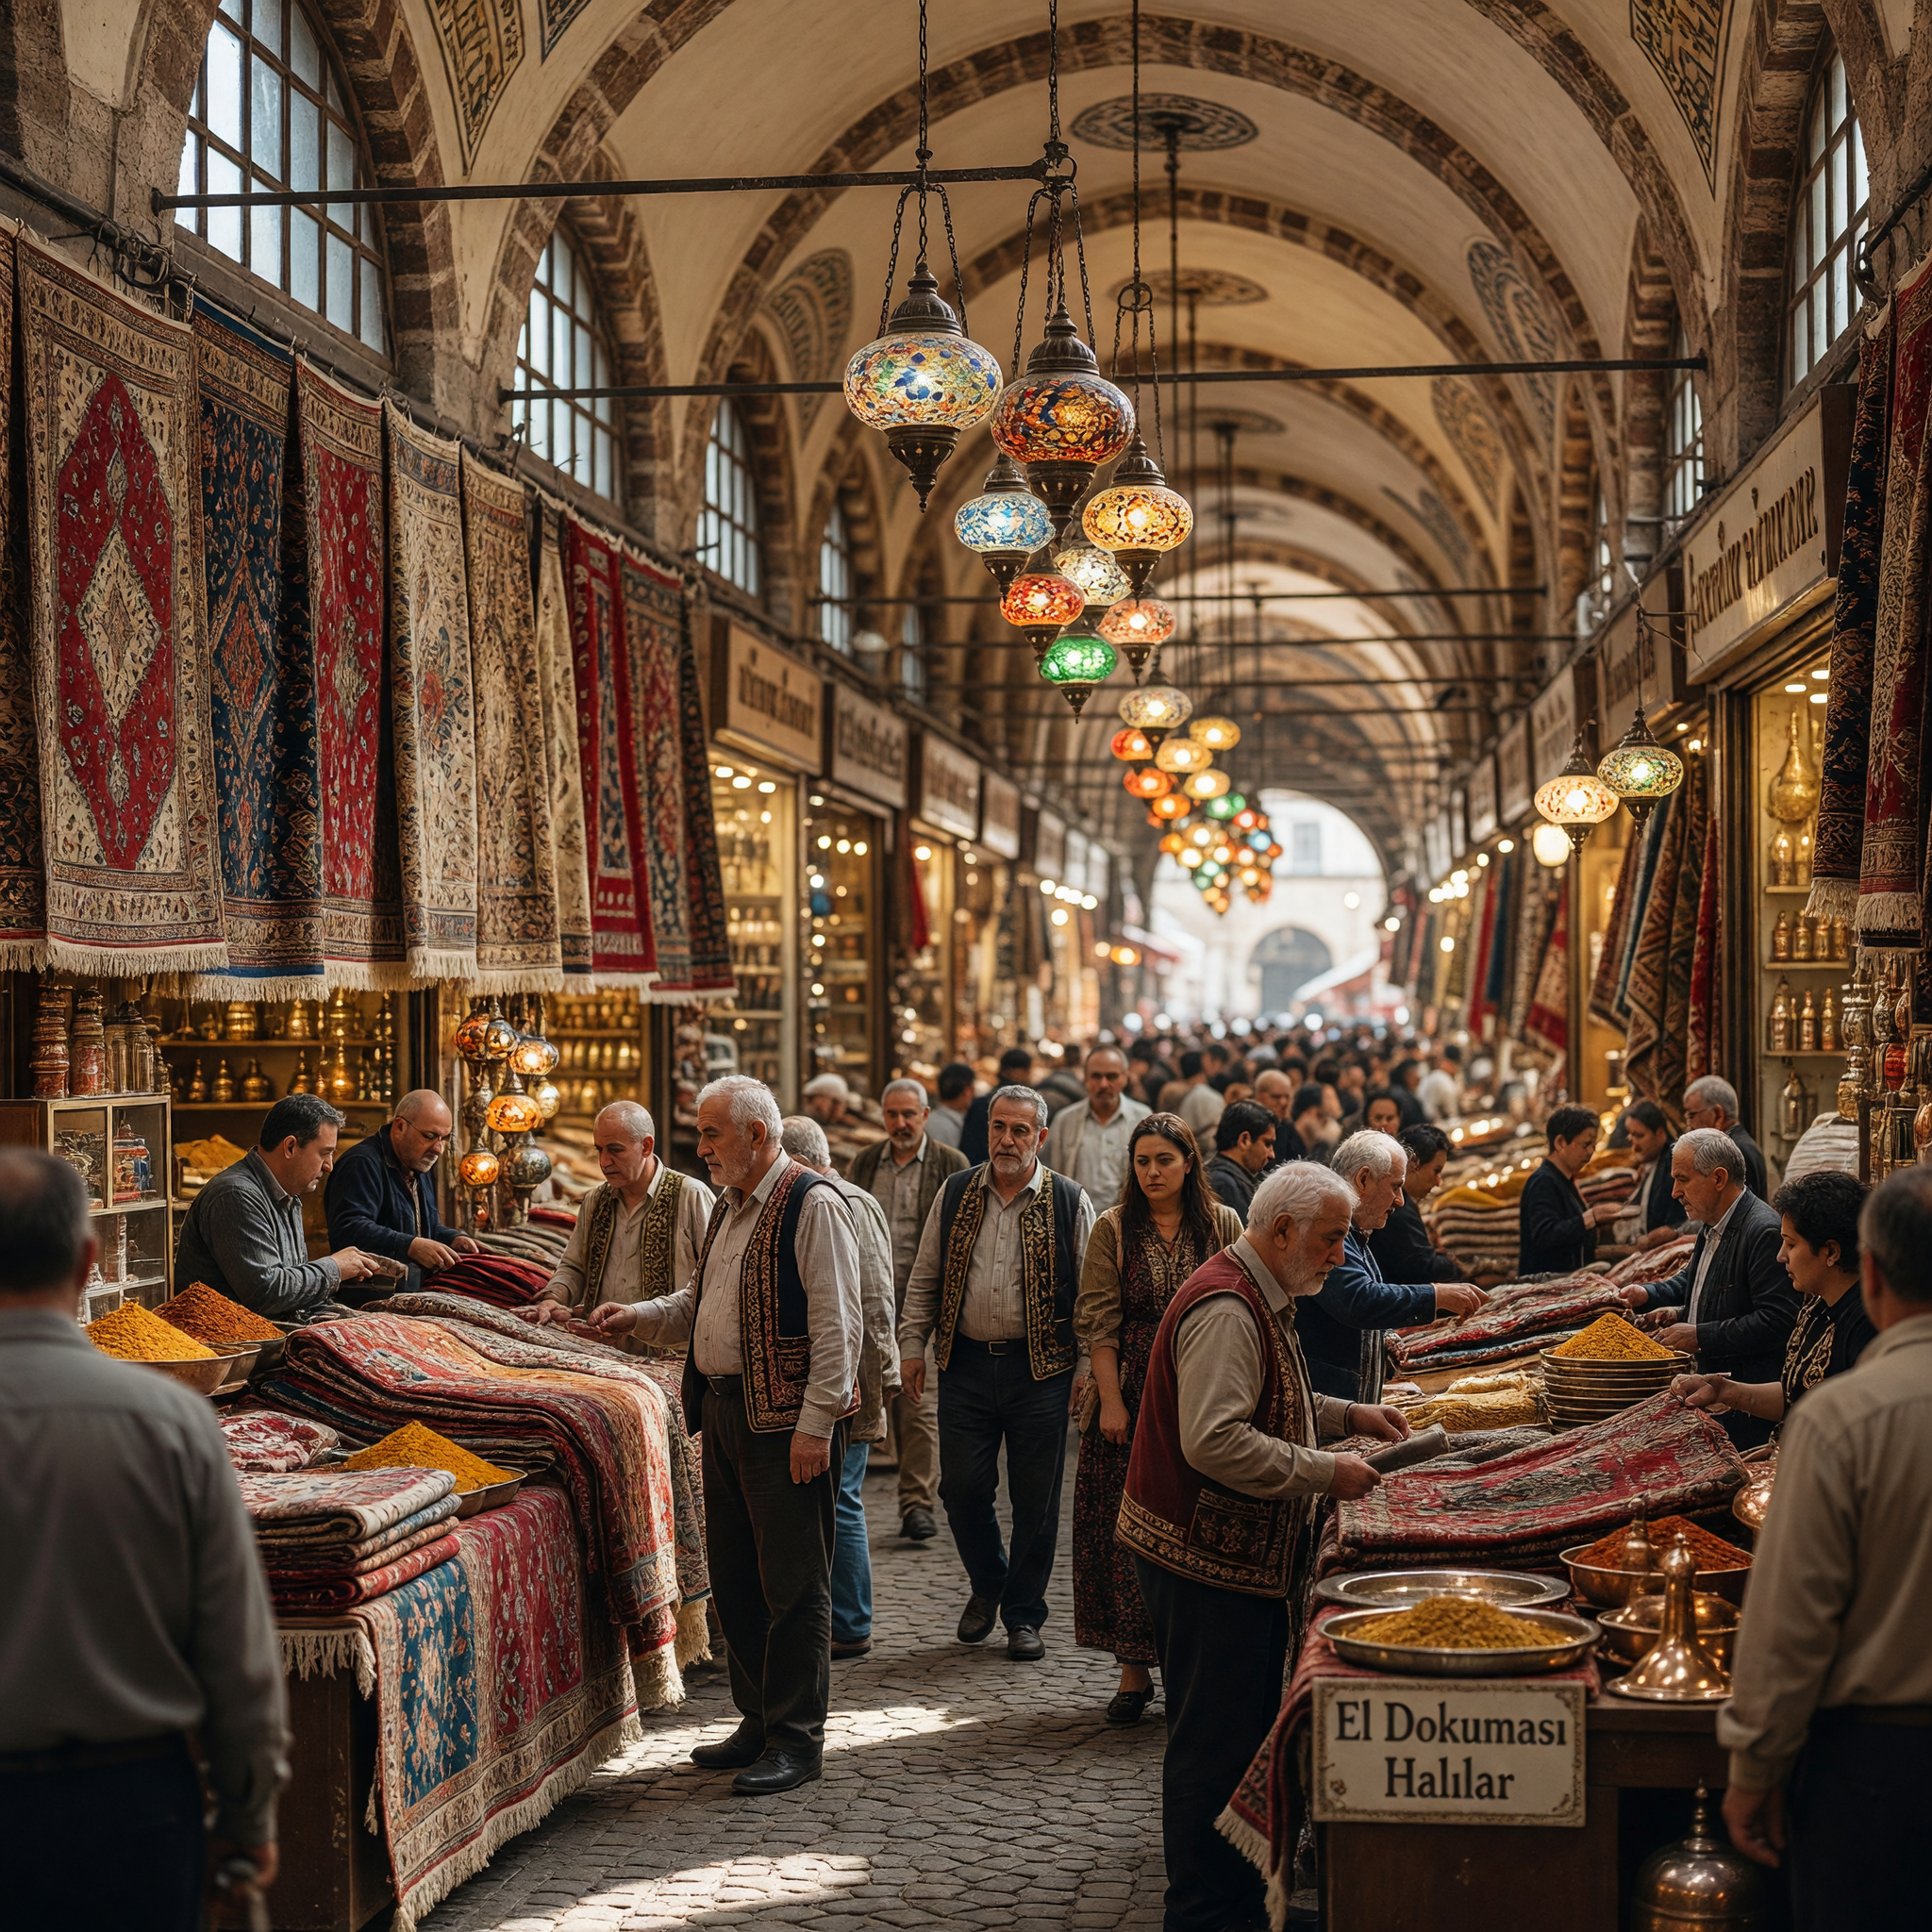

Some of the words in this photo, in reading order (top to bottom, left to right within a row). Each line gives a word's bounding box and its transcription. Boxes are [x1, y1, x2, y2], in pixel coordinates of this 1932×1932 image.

[1335, 1699, 1373, 1740] El
[1383, 1701, 1567, 1745] Dokuması
[1384, 1756, 1515, 1800] Halılar
